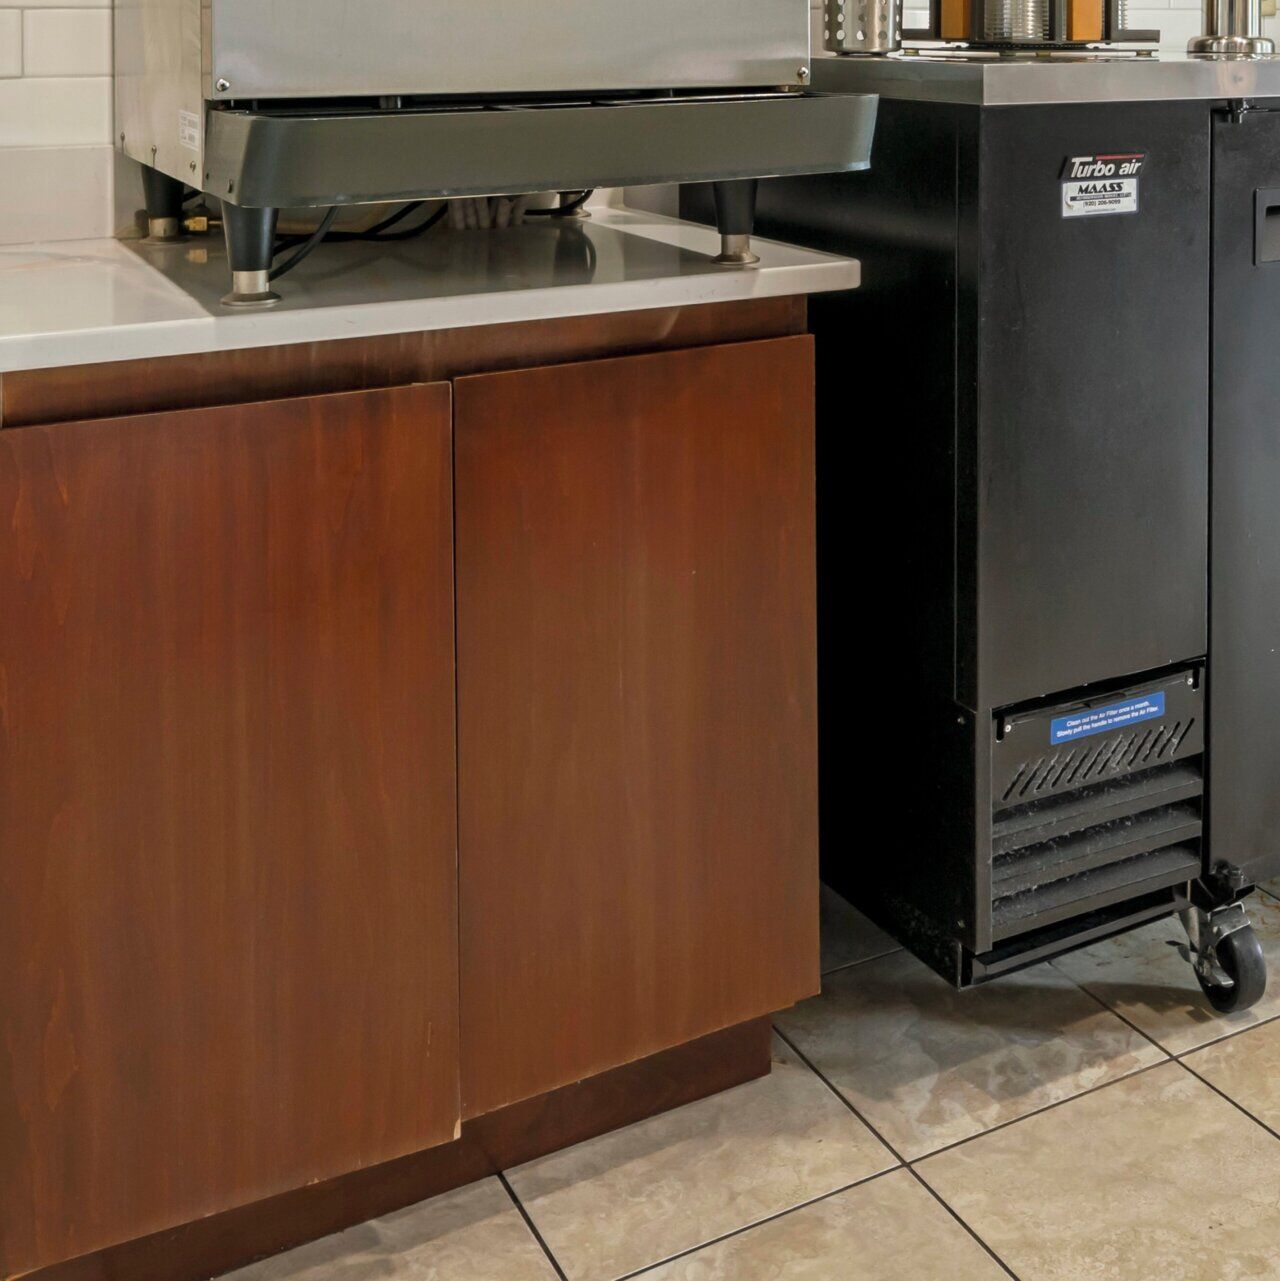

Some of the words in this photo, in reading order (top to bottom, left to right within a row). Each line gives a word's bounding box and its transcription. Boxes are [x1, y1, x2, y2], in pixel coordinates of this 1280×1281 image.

[1070, 156, 1116, 178] Turbo
[1118, 158, 1142, 175] air
[1077, 181, 1124, 195] MAASS
